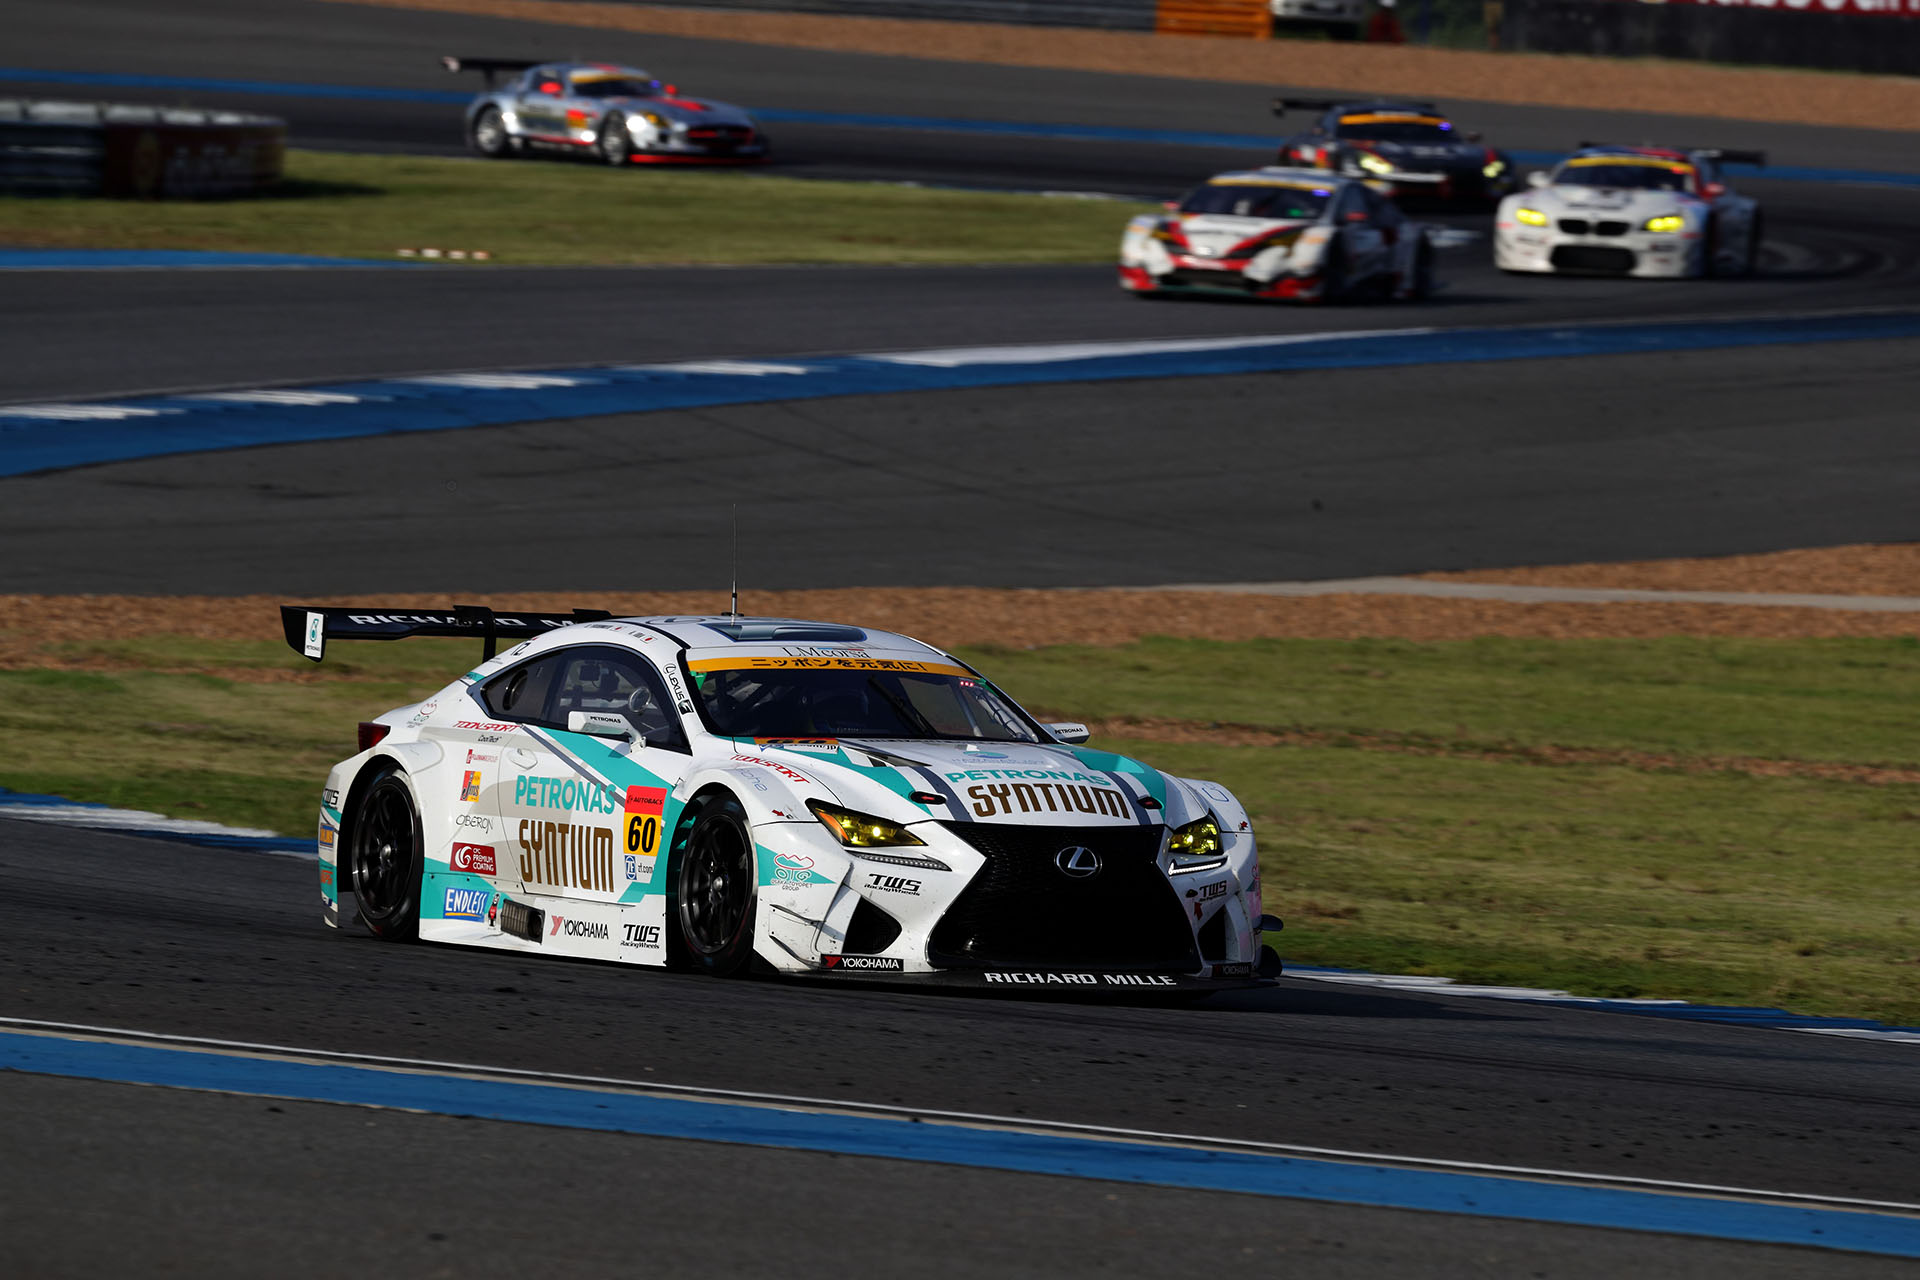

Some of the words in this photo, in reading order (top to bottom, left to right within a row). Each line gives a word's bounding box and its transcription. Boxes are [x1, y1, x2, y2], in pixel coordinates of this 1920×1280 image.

[590, 715, 622, 724] PETRONAS
[944, 769, 1112, 786] PETRONAS
[515, 775, 617, 815] PETRONAS
[967, 783, 1131, 820] SYNTIUM
[627, 815, 657, 853] 60
[472, 854, 494, 863] PREMIUM
[518, 819, 615, 893] SYNTIUM
[472, 862, 494, 871] COATING
[868, 873, 922, 892] TWS
[1199, 880, 1227, 898] TWS
[445, 888, 488, 914] ENDLESS
[563, 919, 609, 940] YOKOHAMA
[623, 923, 661, 943] TWS
[841, 957, 900, 969] YOKOHAMA
[983, 972, 1098, 984] RICHARD
[1102, 974, 1178, 986] MILLE
